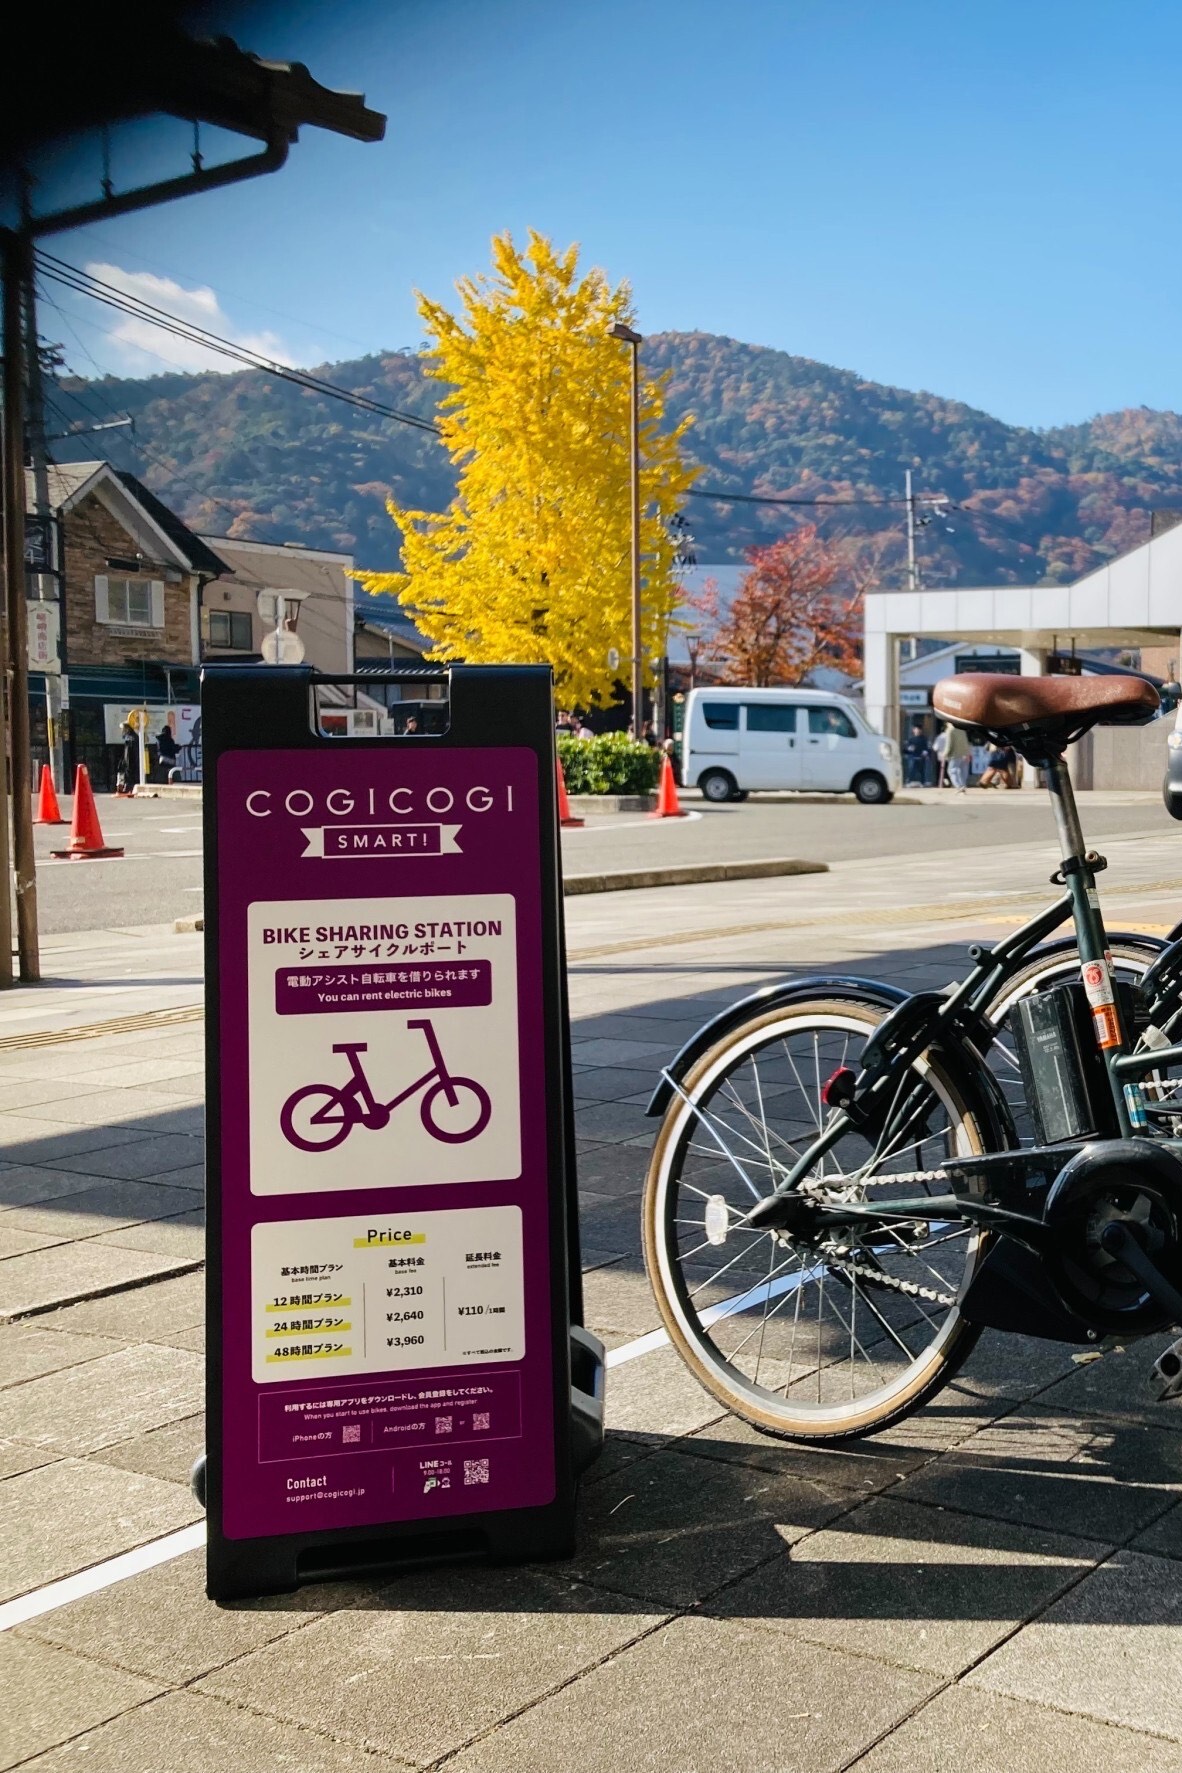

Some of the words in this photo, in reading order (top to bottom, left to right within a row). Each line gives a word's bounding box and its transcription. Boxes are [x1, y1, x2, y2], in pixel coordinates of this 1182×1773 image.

[246, 785, 513, 817] COGICOGI
[338, 833, 427, 848] SMART!
[263, 927, 311, 944] BIKE
[315, 923, 409, 942] SHARING
[414, 920, 502, 939] STATION
[298, 940, 468, 960] シェアサイクルポート
[286, 969, 481, 988] 電動アシスト自転車を借りられます
[318, 993, 338, 1002] You
[340, 993, 360, 1001] can
[362, 991, 382, 1000] rent
[385, 989, 422, 999] electric
[425, 988, 452, 998] bikes
[367, 1228, 412, 1243] Price
[388, 1257, 425, 1268] 基本料金
[465, 1252, 502, 1262] 延長料金
[280, 1264, 344, 1276] 基本時間プラン
[386, 1286, 423, 1298] ¥2,310
[386, 1310, 424, 1323] ¥2,640
[458, 1306, 484, 1316] ¥110
[386, 1335, 425, 1348] ¥3,960
[390, 1404, 419, 1412] download
[384, 1422, 426, 1433] Androidの方
[292, 1432, 333, 1442] iPhoneの方
[420, 1460, 439, 1469] LINE
[287, 1475, 327, 1490] Contact
[286, 1488, 365, 1503] support@cogicogi.jp
